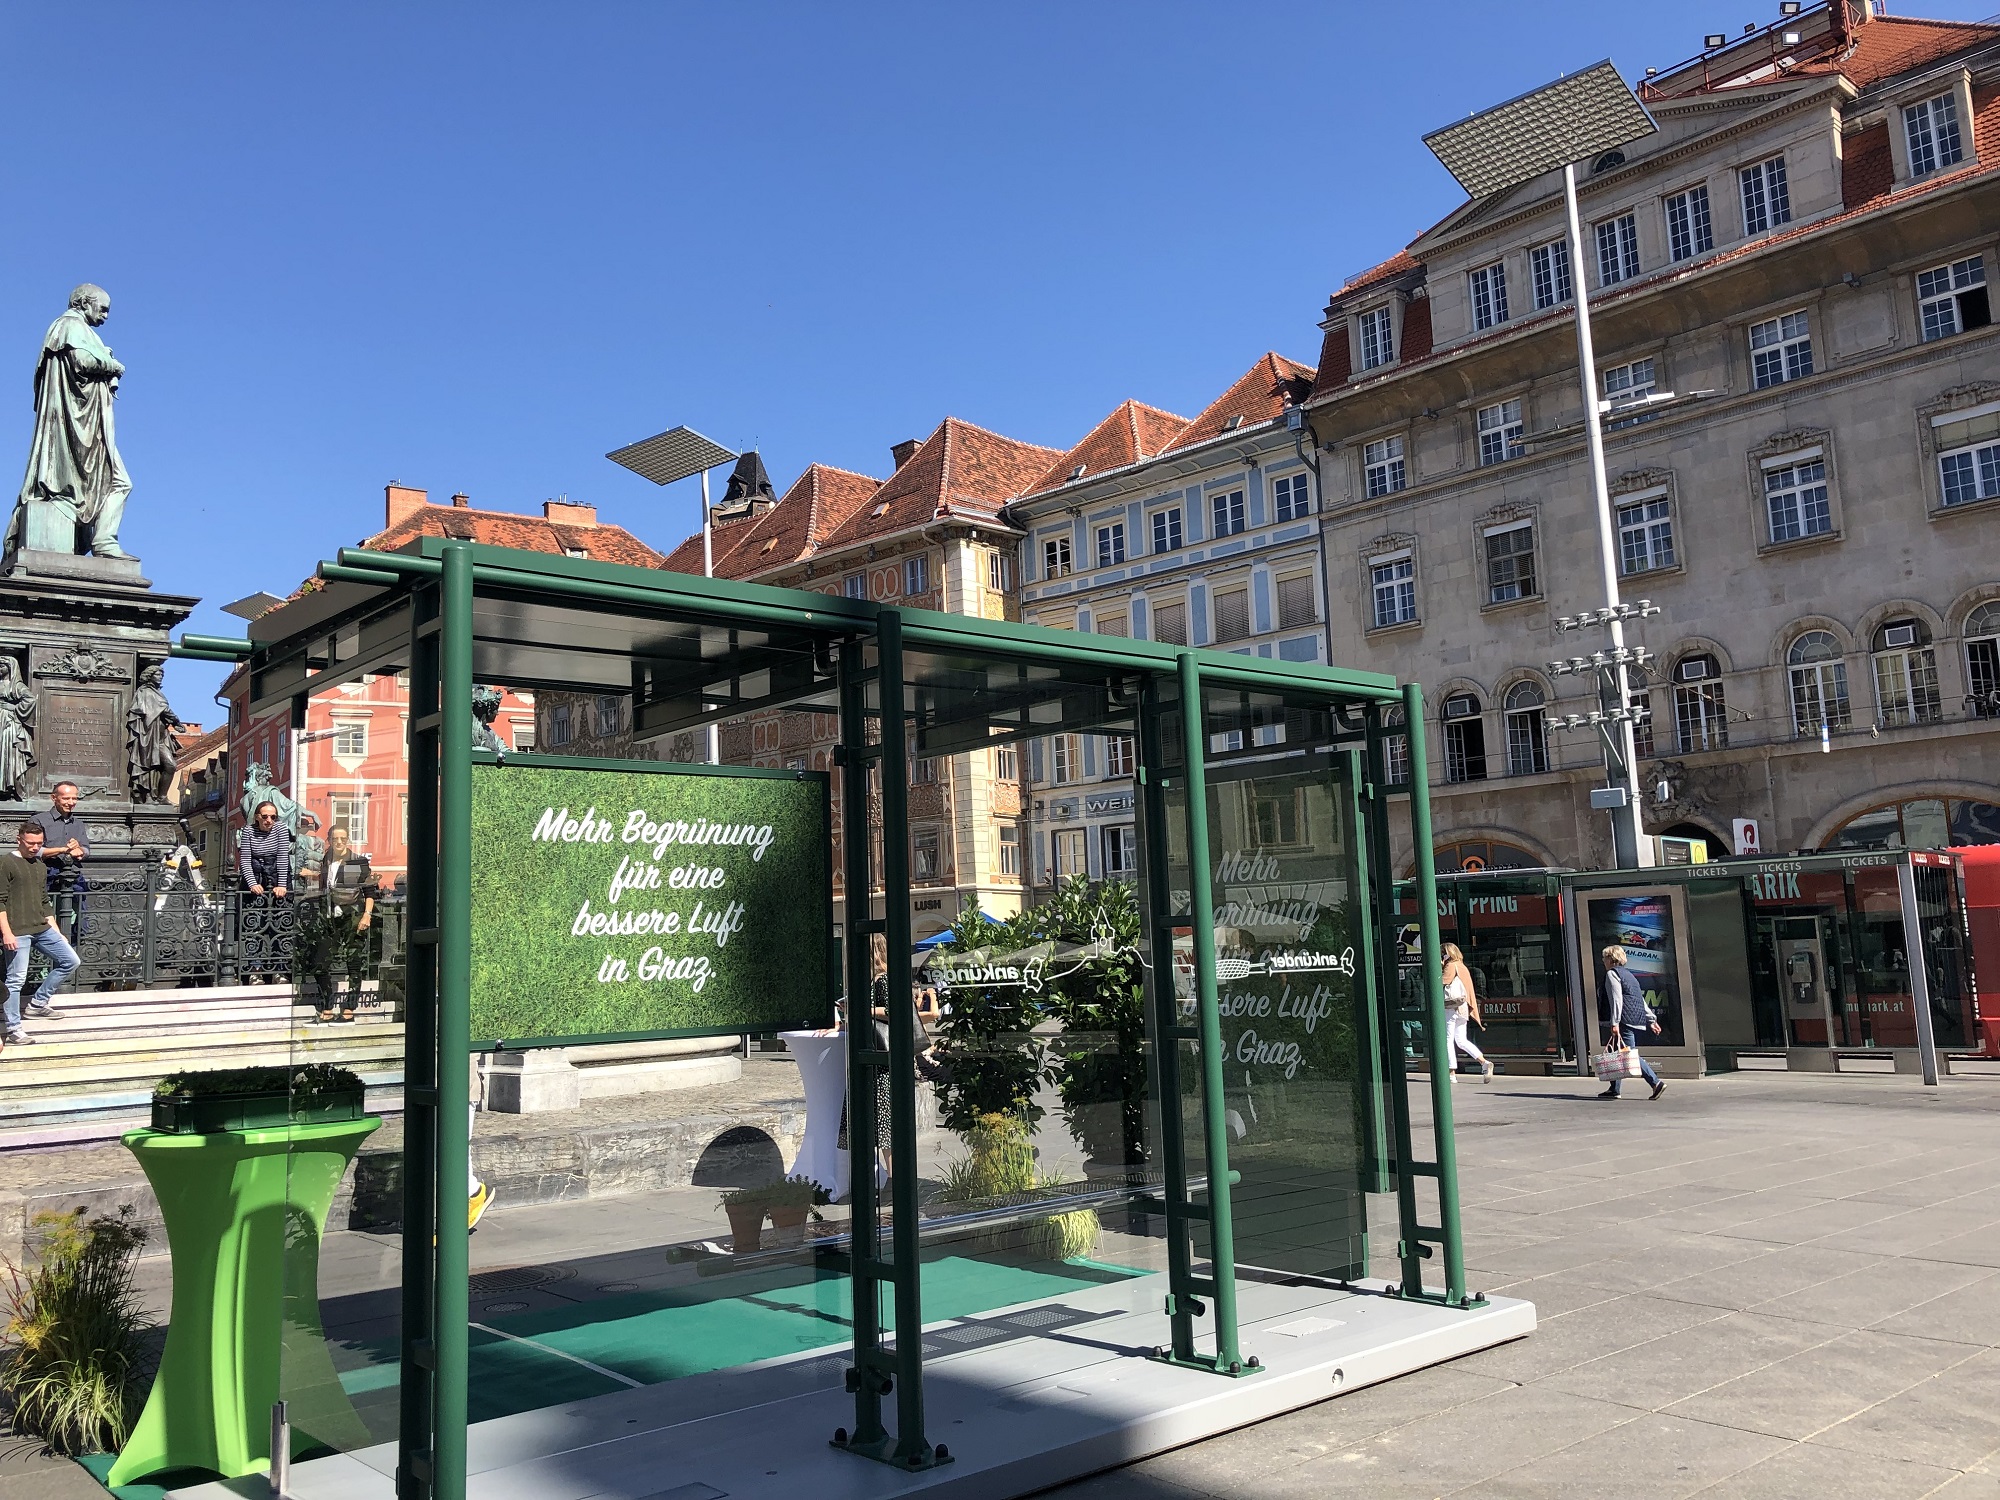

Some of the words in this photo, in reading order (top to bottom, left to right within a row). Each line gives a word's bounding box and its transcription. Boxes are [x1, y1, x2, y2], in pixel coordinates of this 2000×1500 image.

[532, 806, 614, 843] Mehr
[621, 809, 774, 862] Begrünung
[1215, 846, 1280, 883] Mehr
[1686, 867, 1728, 878] TICKETS
[1758, 861, 1802, 873] TICKETS
[1841, 856, 1888, 867] TICKETS
[609, 855, 662, 903] für
[669, 863, 725, 889] eine
[914, 899, 942, 911] LUSH
[1437, 895, 1518, 916] SHPPING
[571, 900, 681, 936] bessere
[688, 901, 745, 947] Luft
[597, 954, 630, 983] in
[638, 946, 717, 993] Graz.
[1277, 983, 1332, 1034] Luft
[1484, 1002, 1521, 1014] GRAZ-OST
[1846, 1000, 1904, 1012] muark.at
[1236, 1029, 1307, 1080] Graz.
